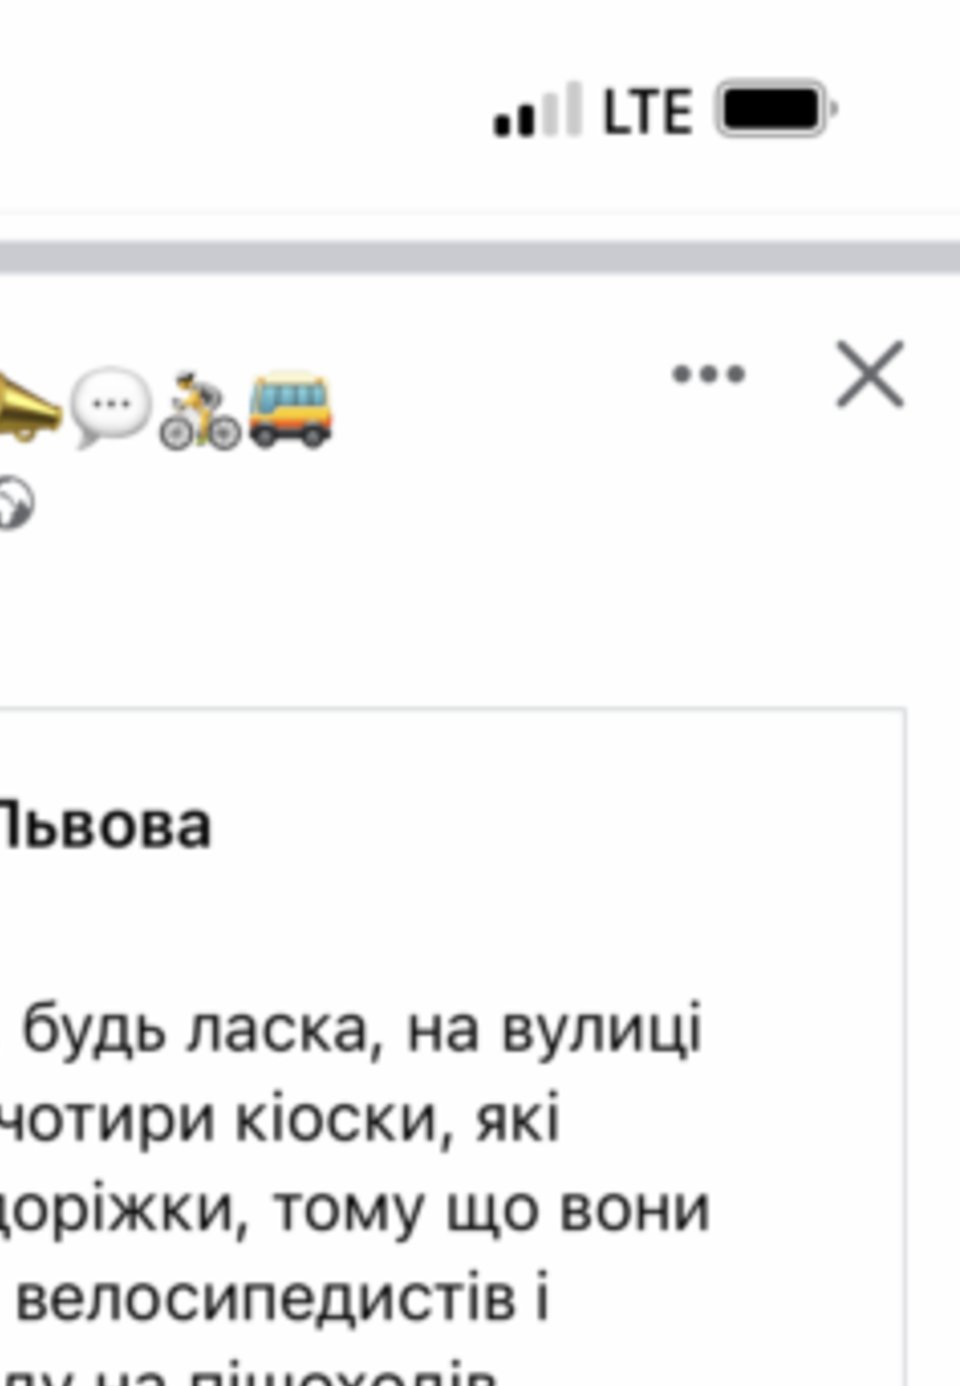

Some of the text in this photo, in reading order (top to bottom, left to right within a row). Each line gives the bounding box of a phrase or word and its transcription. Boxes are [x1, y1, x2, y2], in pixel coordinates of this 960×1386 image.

[603, 86, 694, 136] LTE
[23, 999, 166, 1064] будь
[186, 1013, 382, 1064] ласка,
[409, 1013, 478, 1053] на
[503, 999, 701, 1064] вулиці
[237, 1089, 453, 1153] кіоски,
[476, 1089, 558, 1142] які
[272, 1192, 425, 1244] тому
[448, 1192, 539, 1241] що
[561, 1192, 709, 1232] вони
[17, 1269, 516, 1331] велосипедистів
[536, 1269, 548, 1321] і
